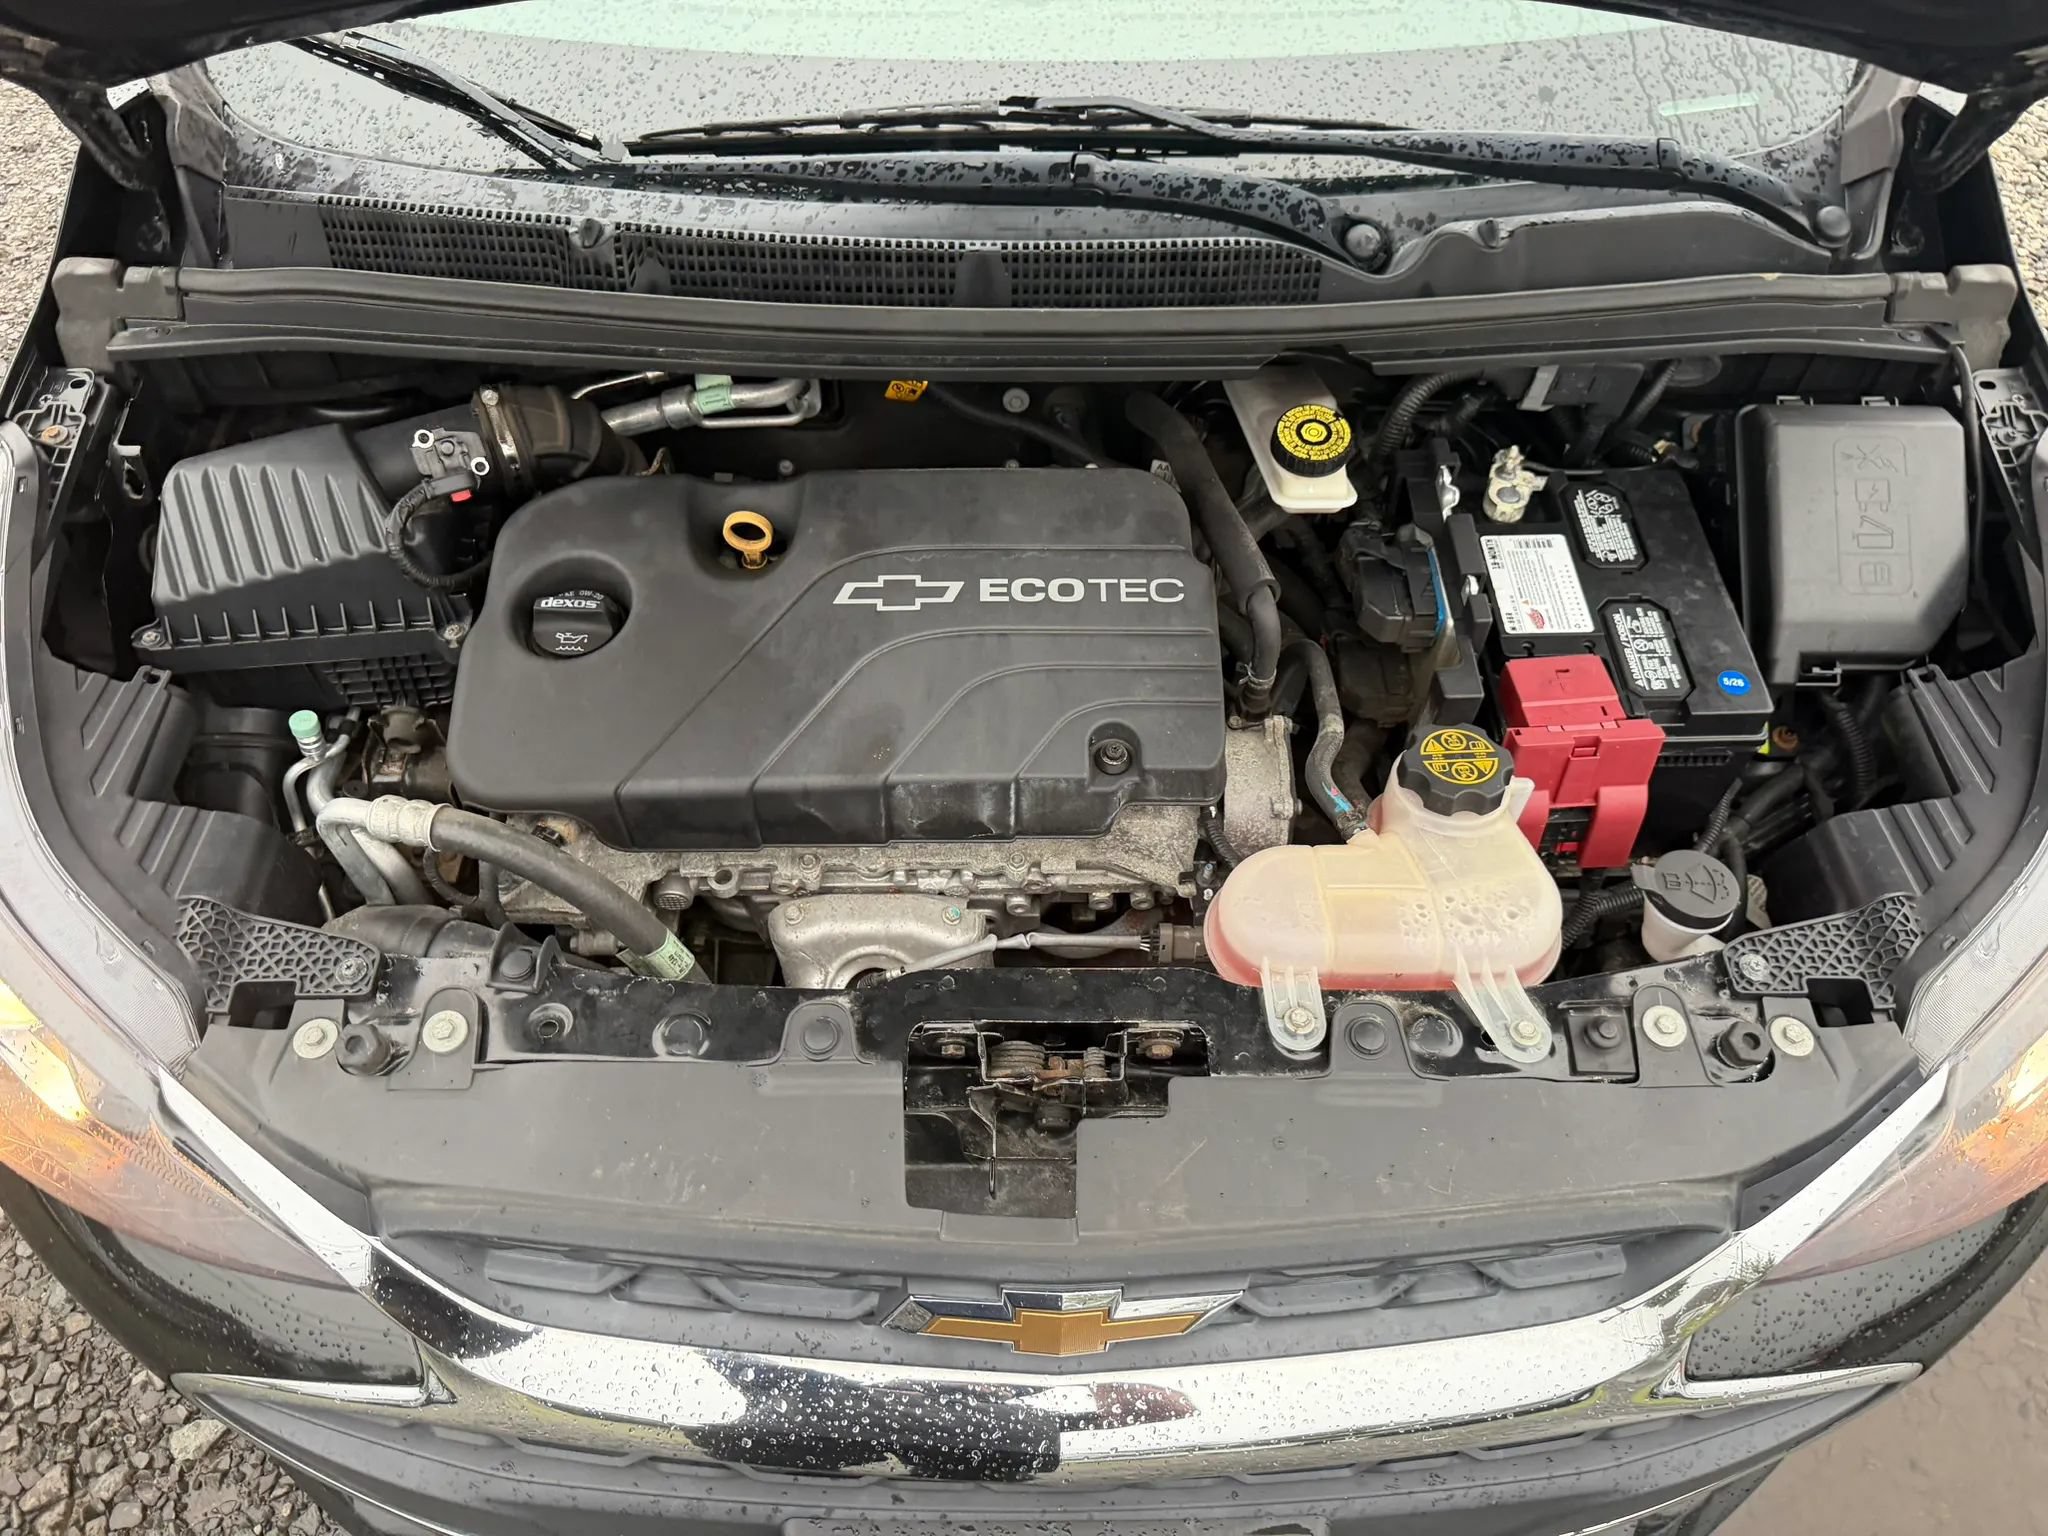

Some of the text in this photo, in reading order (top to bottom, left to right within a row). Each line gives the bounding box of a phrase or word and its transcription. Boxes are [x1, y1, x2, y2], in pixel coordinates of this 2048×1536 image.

[541, 597, 600, 608] dexos
[979, 577, 1185, 602] ECOTEC
[1612, 613, 1629, 641] POISON
[1623, 648, 1642, 679] DANGER
